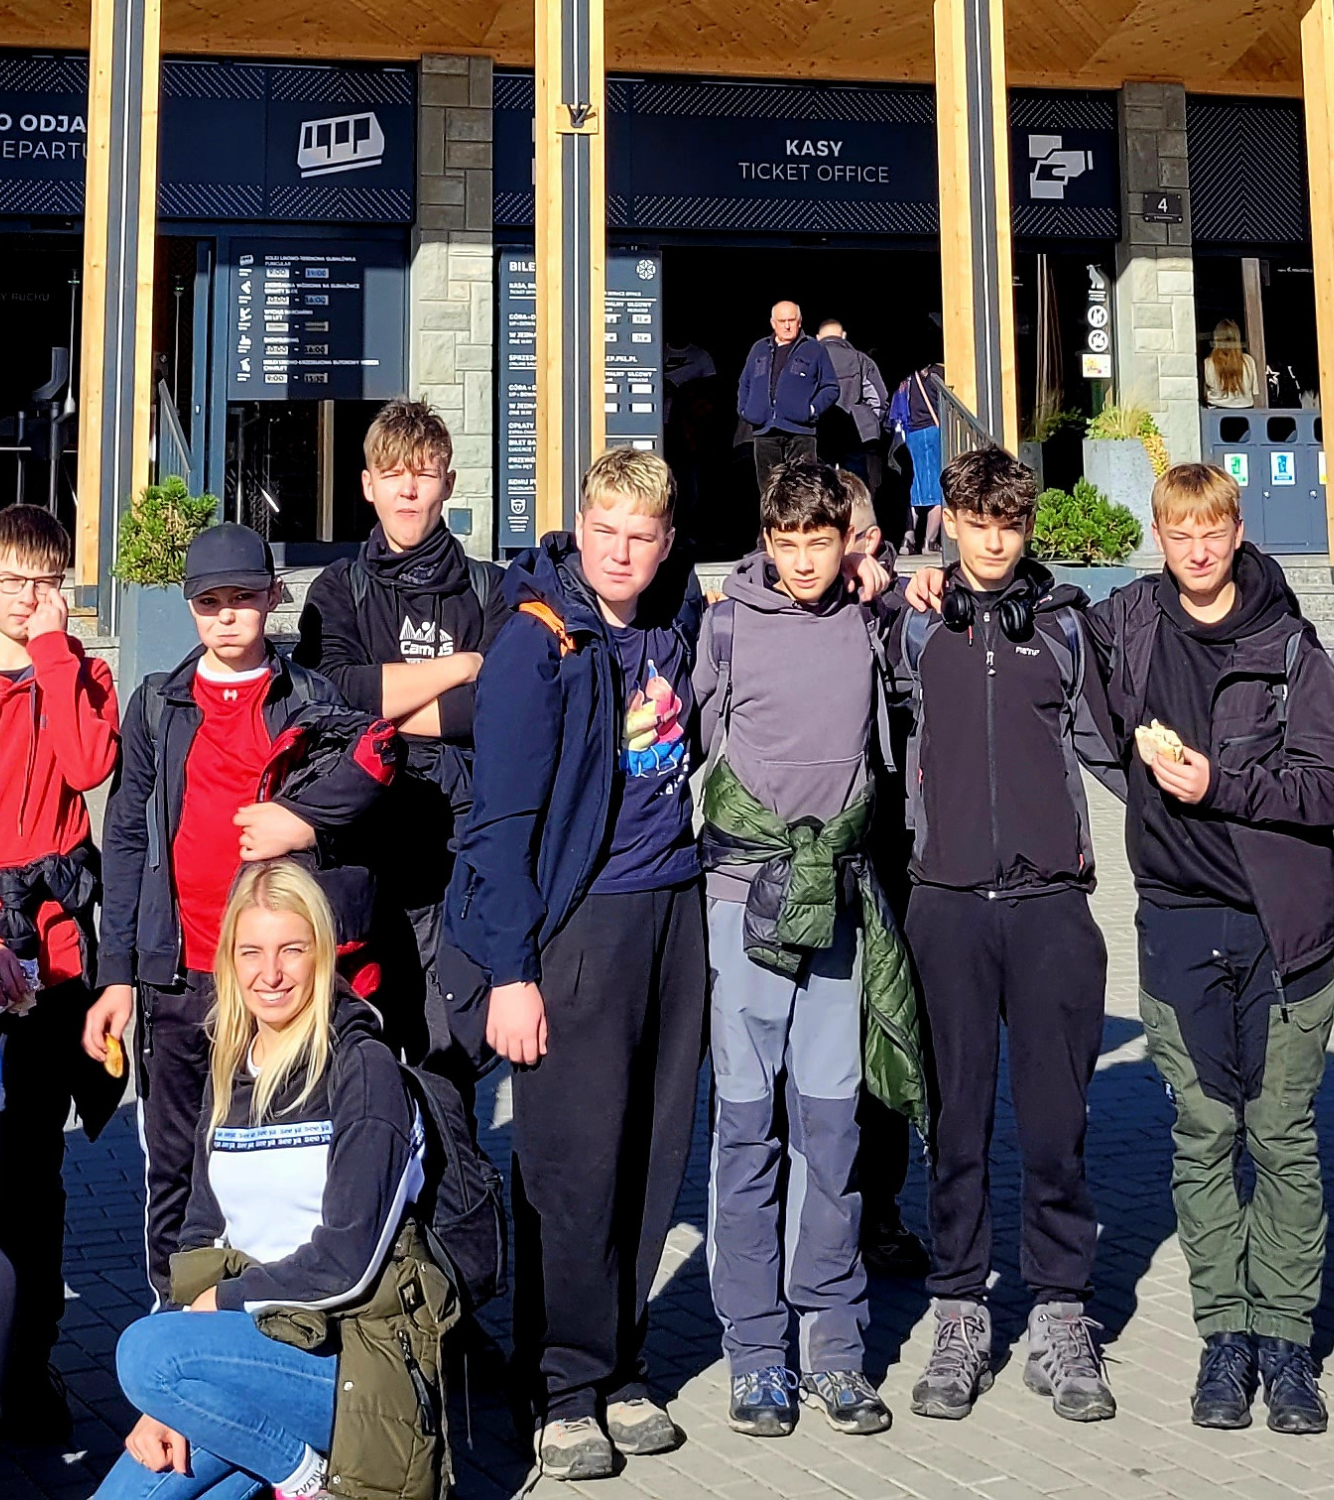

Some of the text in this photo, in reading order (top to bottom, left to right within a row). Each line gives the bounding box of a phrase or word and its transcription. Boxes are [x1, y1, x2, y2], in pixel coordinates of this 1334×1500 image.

[19, 113, 87, 133] ODJA
[785, 139, 844, 158] KASY
[738, 161, 890, 183] TICKET OFFICE
[1157, 197, 1168, 213] 4
[400, 640, 454, 659] Cams
